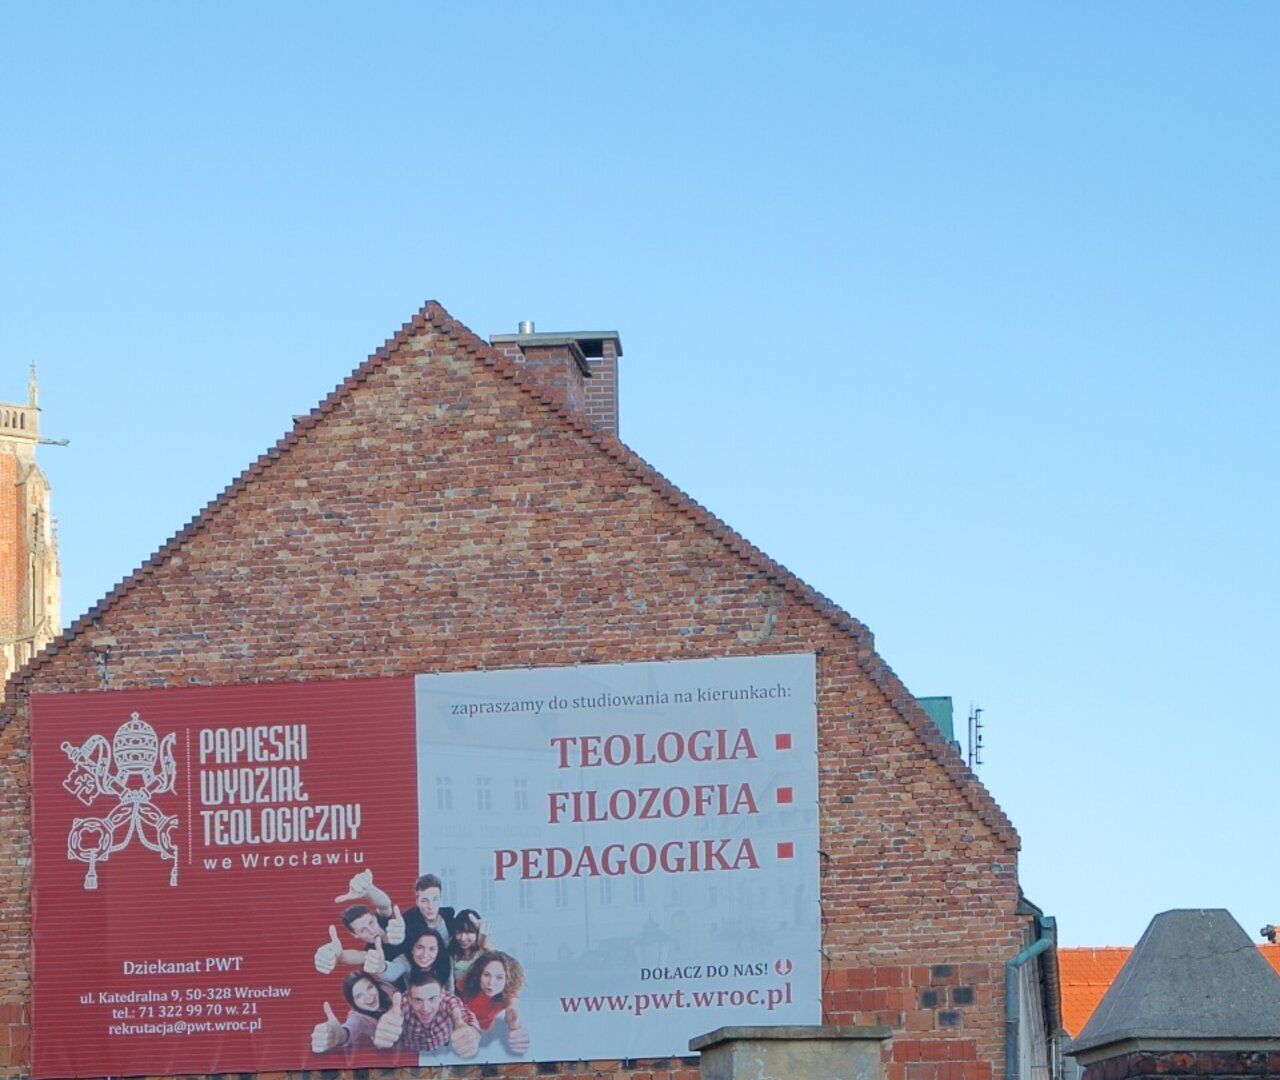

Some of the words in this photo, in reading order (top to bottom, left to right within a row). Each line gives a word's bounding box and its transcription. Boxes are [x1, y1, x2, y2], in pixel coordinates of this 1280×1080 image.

[451, 700, 544, 718] zapraszamy
[548, 694, 569, 711] do
[572, 691, 669, 709] studiowania
[674, 692, 694, 704] na
[697, 684, 792, 703] kierunkach:
[199, 724, 308, 764] PAPIESKI
[550, 727, 758, 769] TEOLOGIA
[200, 766, 309, 805] WYDZIAŁ
[547, 782, 760, 824] FILOZOFIA
[200, 803, 362, 846] TEOLOGICZNY
[204, 856, 233, 870] we
[241, 849, 364, 869] Wrocławiu
[493, 837, 760, 882] PEDAGOGIKA
[123, 959, 202, 975] Dziekanat
[205, 956, 243, 973] PWT
[706, 965, 729, 978] DO
[733, 962, 768, 977] NAS!
[80, 992, 96, 1005] ul.
[98, 989, 168, 1005] Katedralna
[170, 989, 184, 1004] 9,
[185, 987, 232, 1001] 50-328
[234, 985, 292, 999] Wrocław
[112, 1006, 136, 1020] tel.:
[138, 1006, 153, 1018] 71
[158, 1005, 182, 1018] 322
[185, 1004, 203, 1017] 99
[205, 1004, 223, 1016] 70
[242, 1003, 258, 1015] 21
[560, 981, 792, 1016] www.pwt.wroc.pl
[108, 1018, 262, 1036] rekrutacja@pwt.wroc.pl
